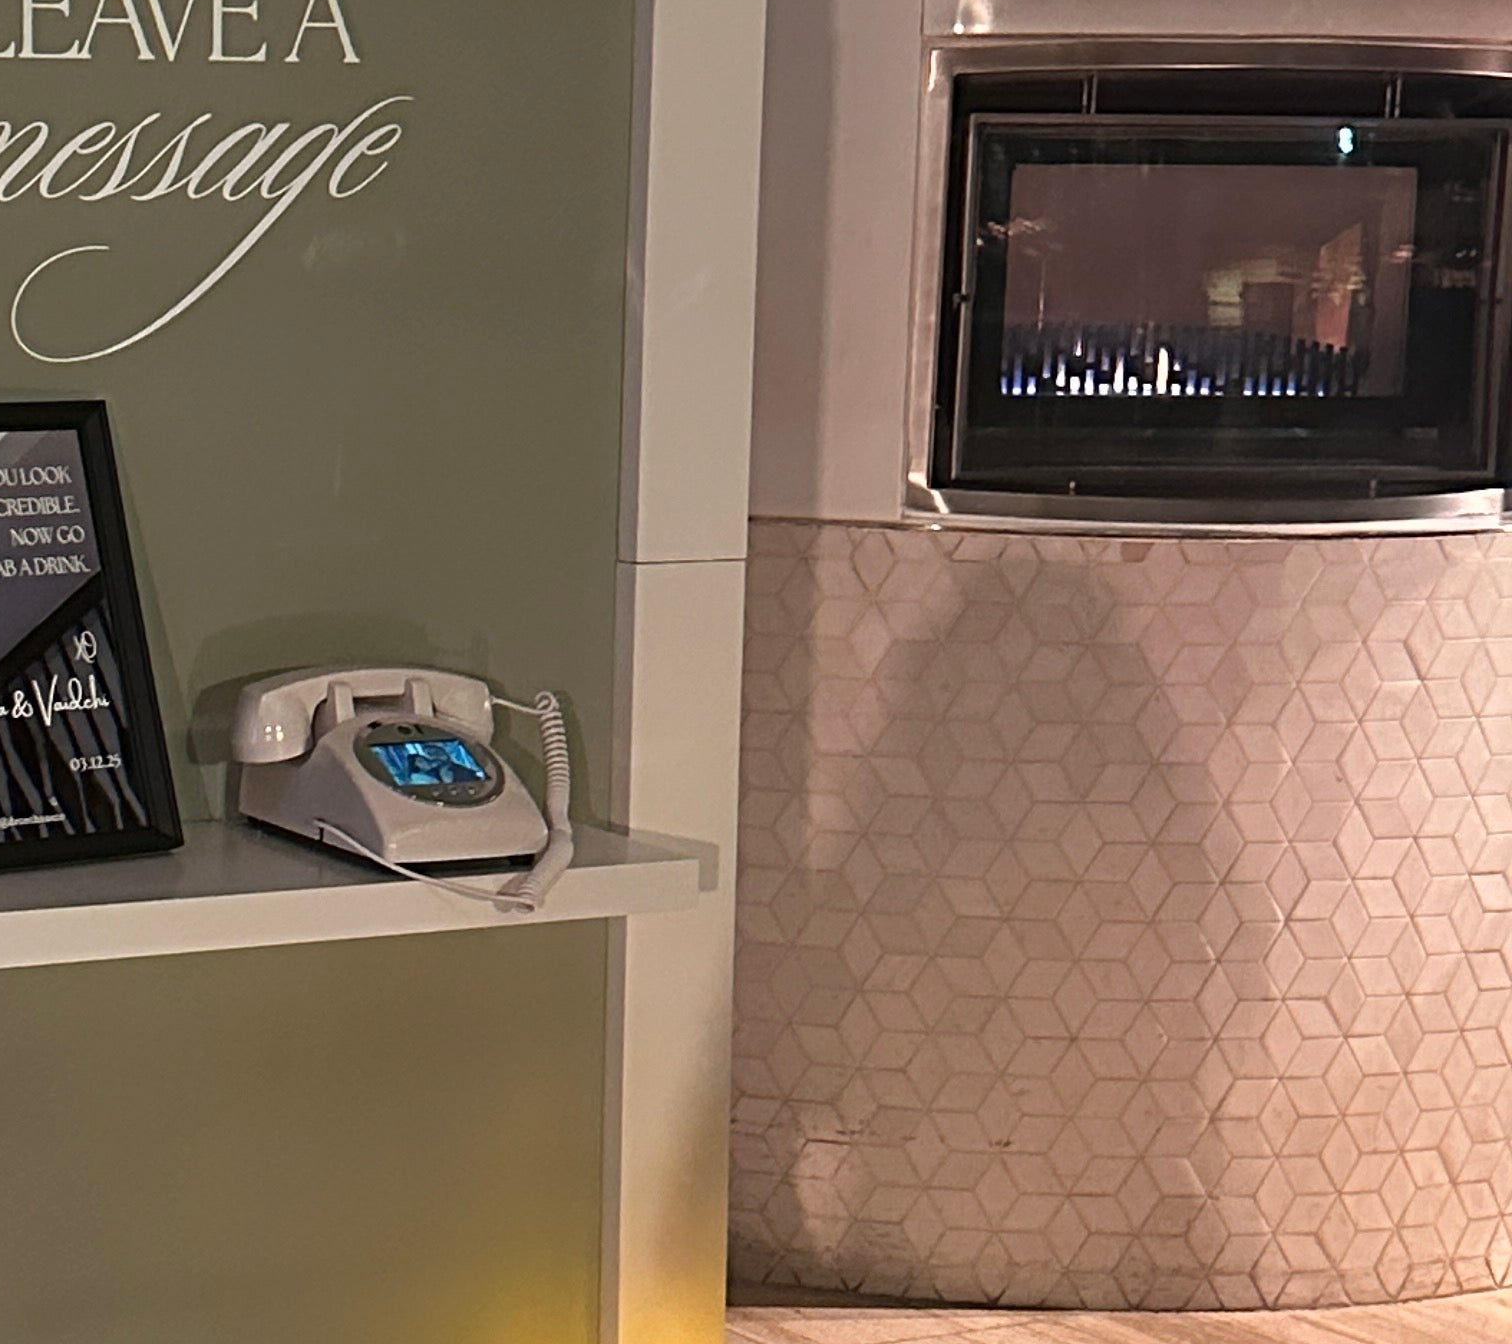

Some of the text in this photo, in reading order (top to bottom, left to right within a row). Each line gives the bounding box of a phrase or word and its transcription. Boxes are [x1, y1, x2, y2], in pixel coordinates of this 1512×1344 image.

[19, 465, 73, 486] LOOK
[9, 524, 85, 547] NOW GO
[18, 557, 34, 576] A
[11, 689, 34, 719] &
